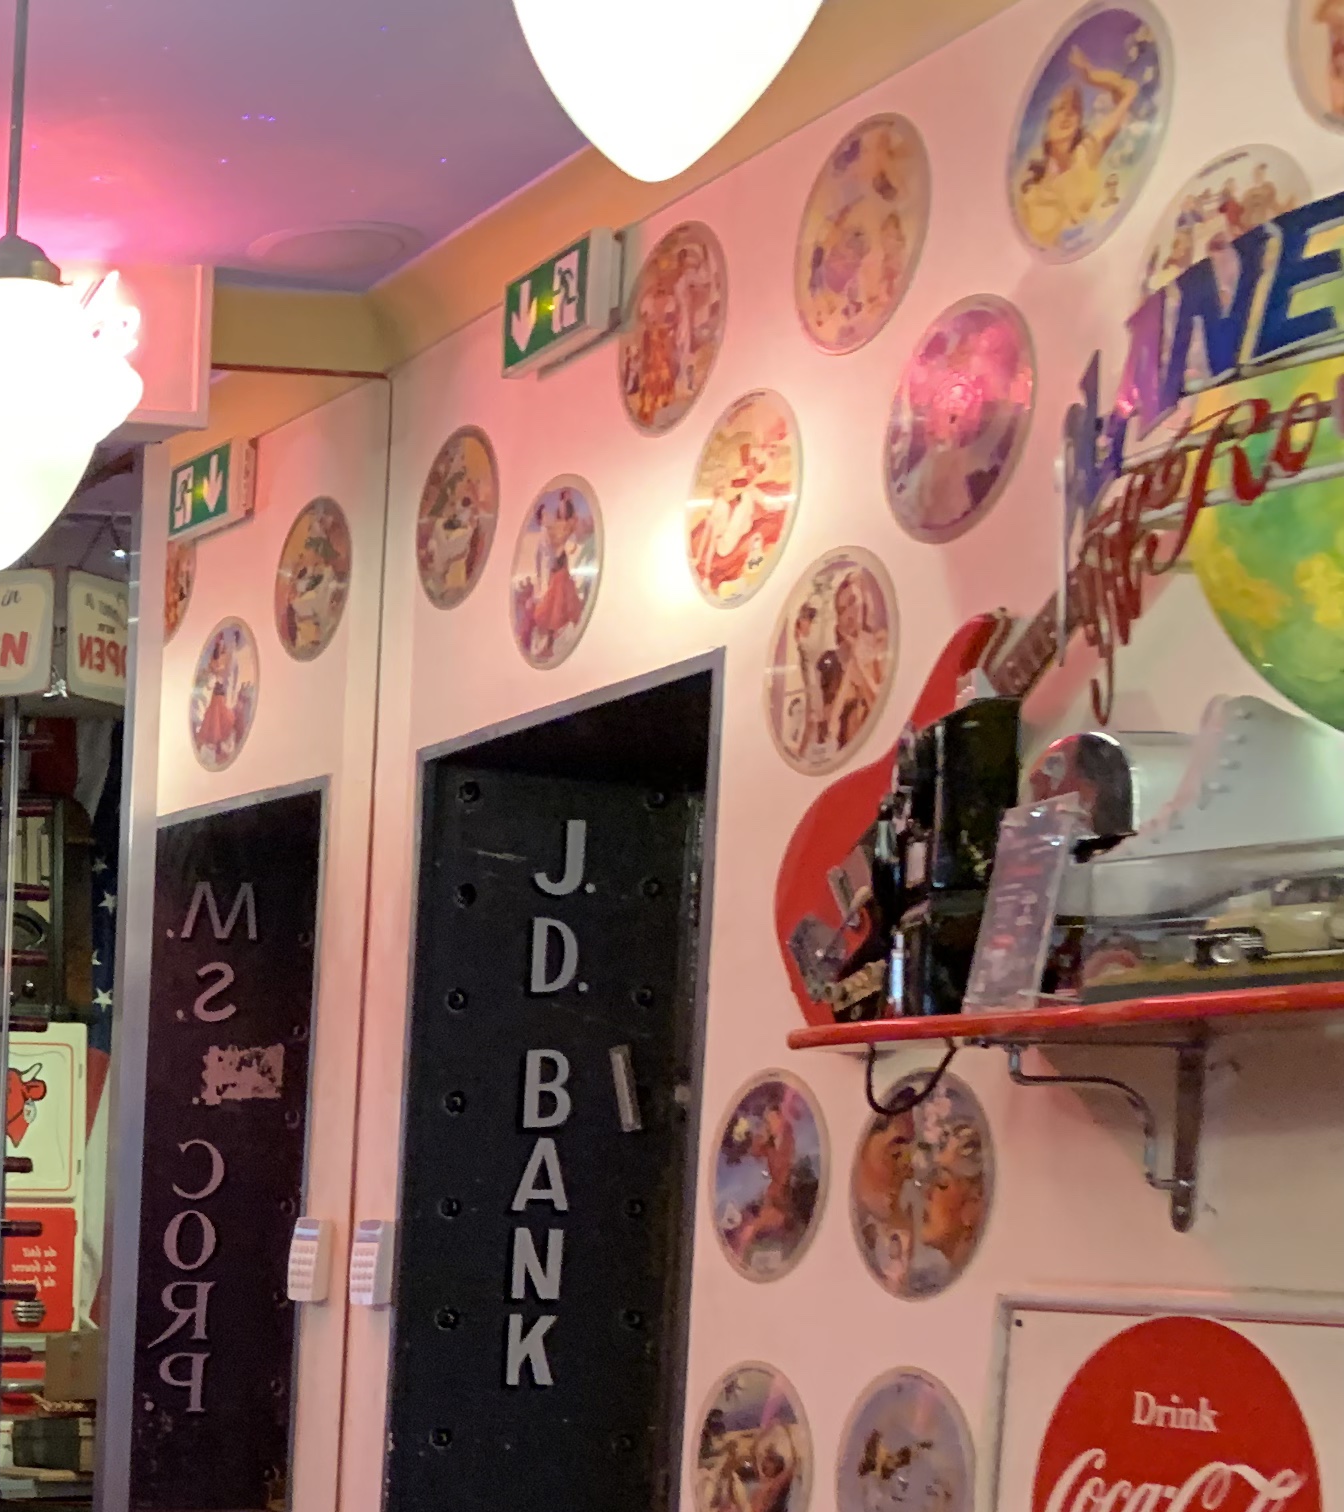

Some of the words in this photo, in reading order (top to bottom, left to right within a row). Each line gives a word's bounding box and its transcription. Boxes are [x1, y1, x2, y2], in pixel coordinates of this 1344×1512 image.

[1, 588, 22, 607] in
[506, 1049, 572, 1386] BANK
[1132, 1390, 1220, 1434] Drink
